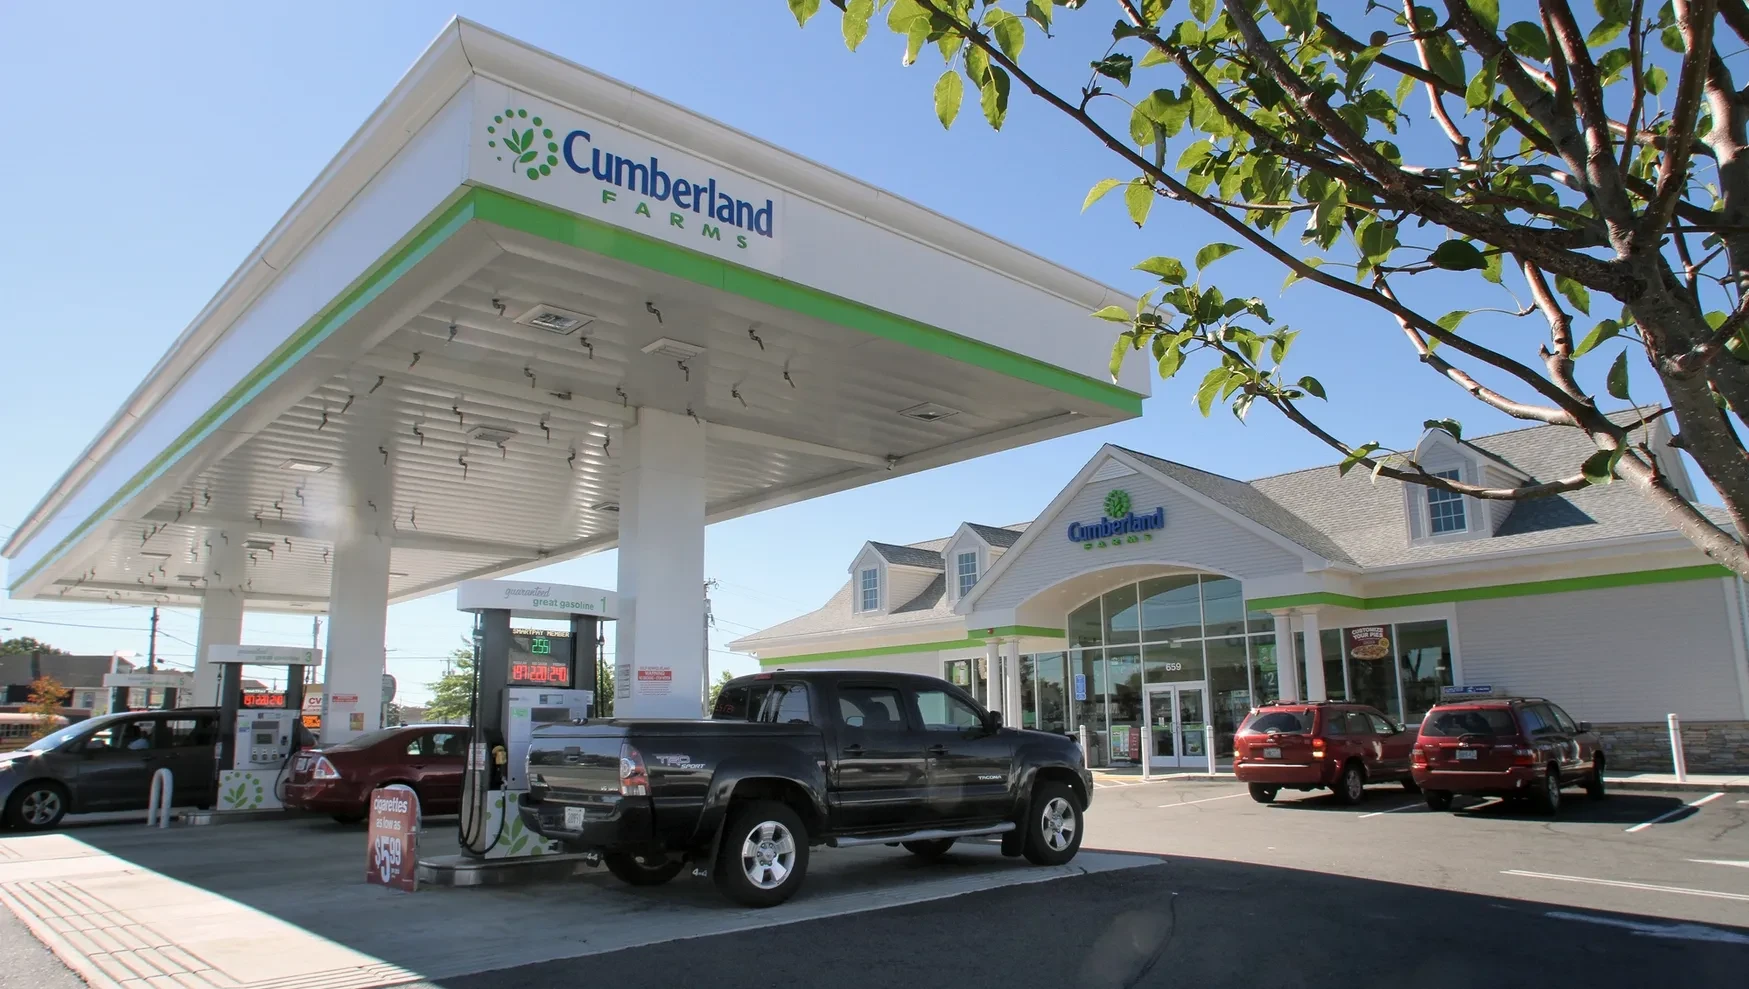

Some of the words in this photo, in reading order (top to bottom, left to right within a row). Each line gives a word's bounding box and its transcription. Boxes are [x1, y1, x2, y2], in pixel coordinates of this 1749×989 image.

[563, 130, 773, 238] Cumberland
[602, 189, 748, 249] FARMS
[1067, 507, 1165, 542] Cumberland
[504, 587, 551, 599] guaranteed
[533, 598, 558, 607] great
[559, 600, 594, 610] gasoline
[600, 597, 606, 612] 1
[1351, 627, 1384, 635] CUSTOMIZE
[1353, 632, 1369, 640] YOUR
[531, 638, 549, 654] 255
[305, 651, 312, 662] 3
[1165, 662, 1182, 671] 659
[654, 754, 690, 766] TRD
[373, 796, 408, 814] cigarettes
[376, 818, 382, 828] as
[383, 816, 392, 829] low
[393, 819, 401, 830] as
